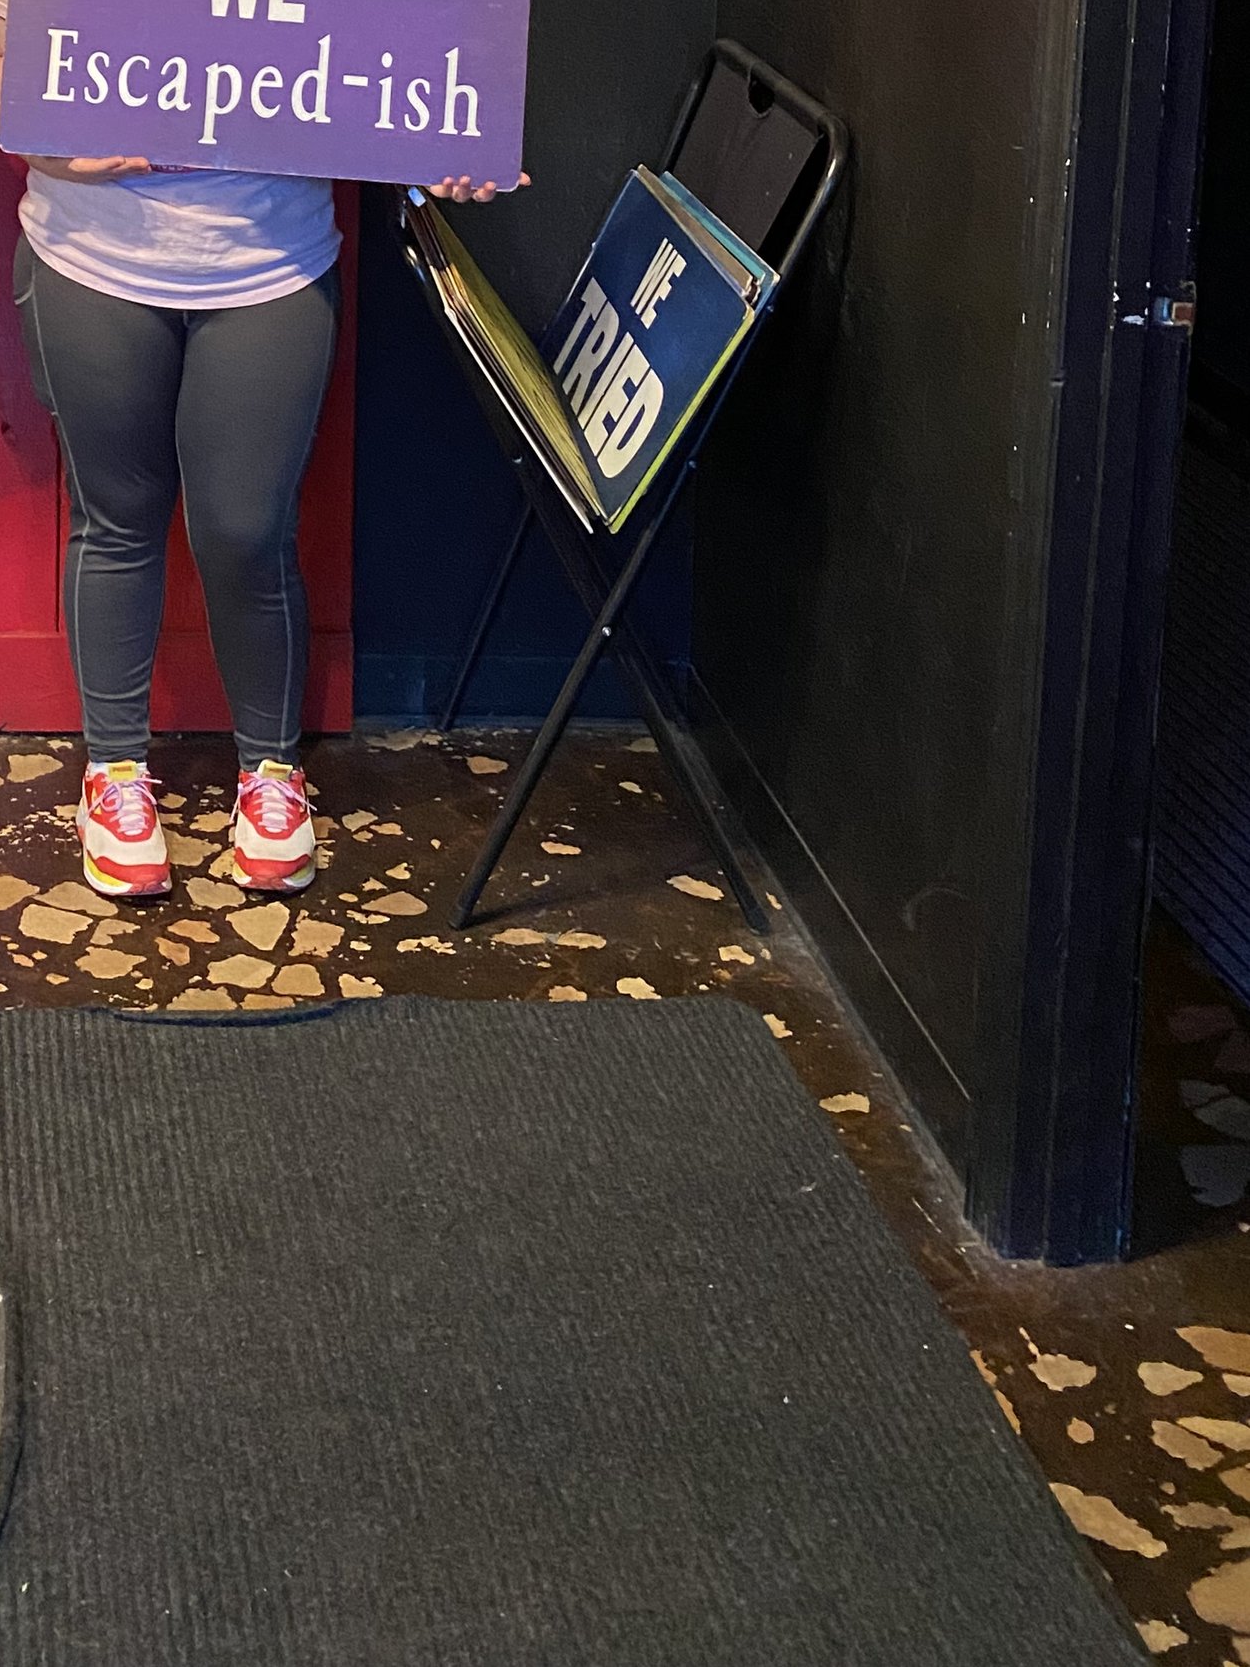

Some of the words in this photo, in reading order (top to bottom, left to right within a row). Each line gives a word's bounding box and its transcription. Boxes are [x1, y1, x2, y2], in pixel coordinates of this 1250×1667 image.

[41, 28, 481, 145] Escaped-ish
[630, 237, 687, 329] WE
[553, 277, 664, 479] TRIED
